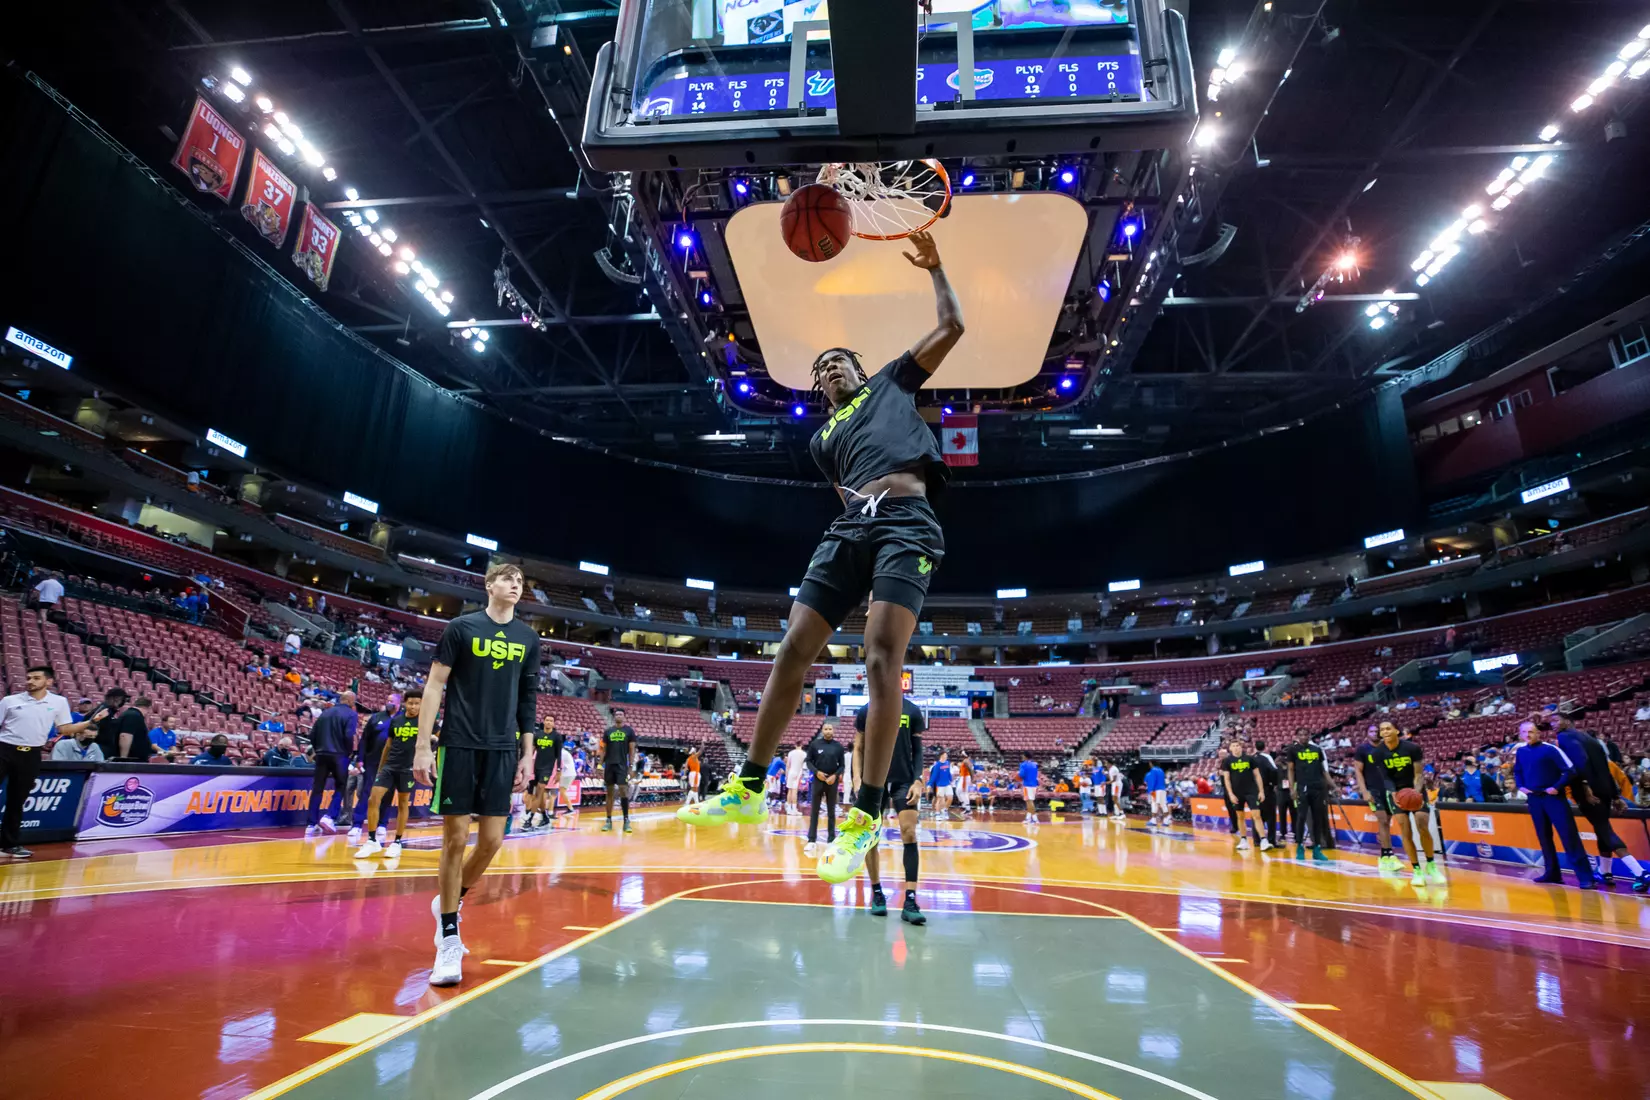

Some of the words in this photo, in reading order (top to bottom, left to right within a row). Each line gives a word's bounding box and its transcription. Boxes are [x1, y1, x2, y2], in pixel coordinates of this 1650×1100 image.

[1015, 65, 1043, 74] PLYR
[1059, 64, 1079, 72] FLS
[1097, 61, 1119, 71] PTS
[1069, 74, 1076, 82] 0
[1107, 72, 1114, 80] 0
[688, 82, 714, 91] PLYR
[728, 81, 747, 89] FLS
[764, 79, 784, 87] PTS
[1025, 85, 1040, 93] 12
[1069, 83, 1077, 92] 0
[734, 90, 741, 98] 0
[769, 88, 777, 96] 0
[691, 102, 706, 110] 14
[733, 100, 740, 108] 0
[769, 98, 776, 106] 0
[199, 105, 241, 149] LUONGO
[207, 132, 219, 155] 1
[263, 179, 284, 206] 37
[15, 331, 65, 361] amazon
[212, 431, 242, 451] amazon
[1527, 480, 1563, 497] amazon
[393, 727, 419, 737] USF
[184, 789, 313, 815] AUTONATION
